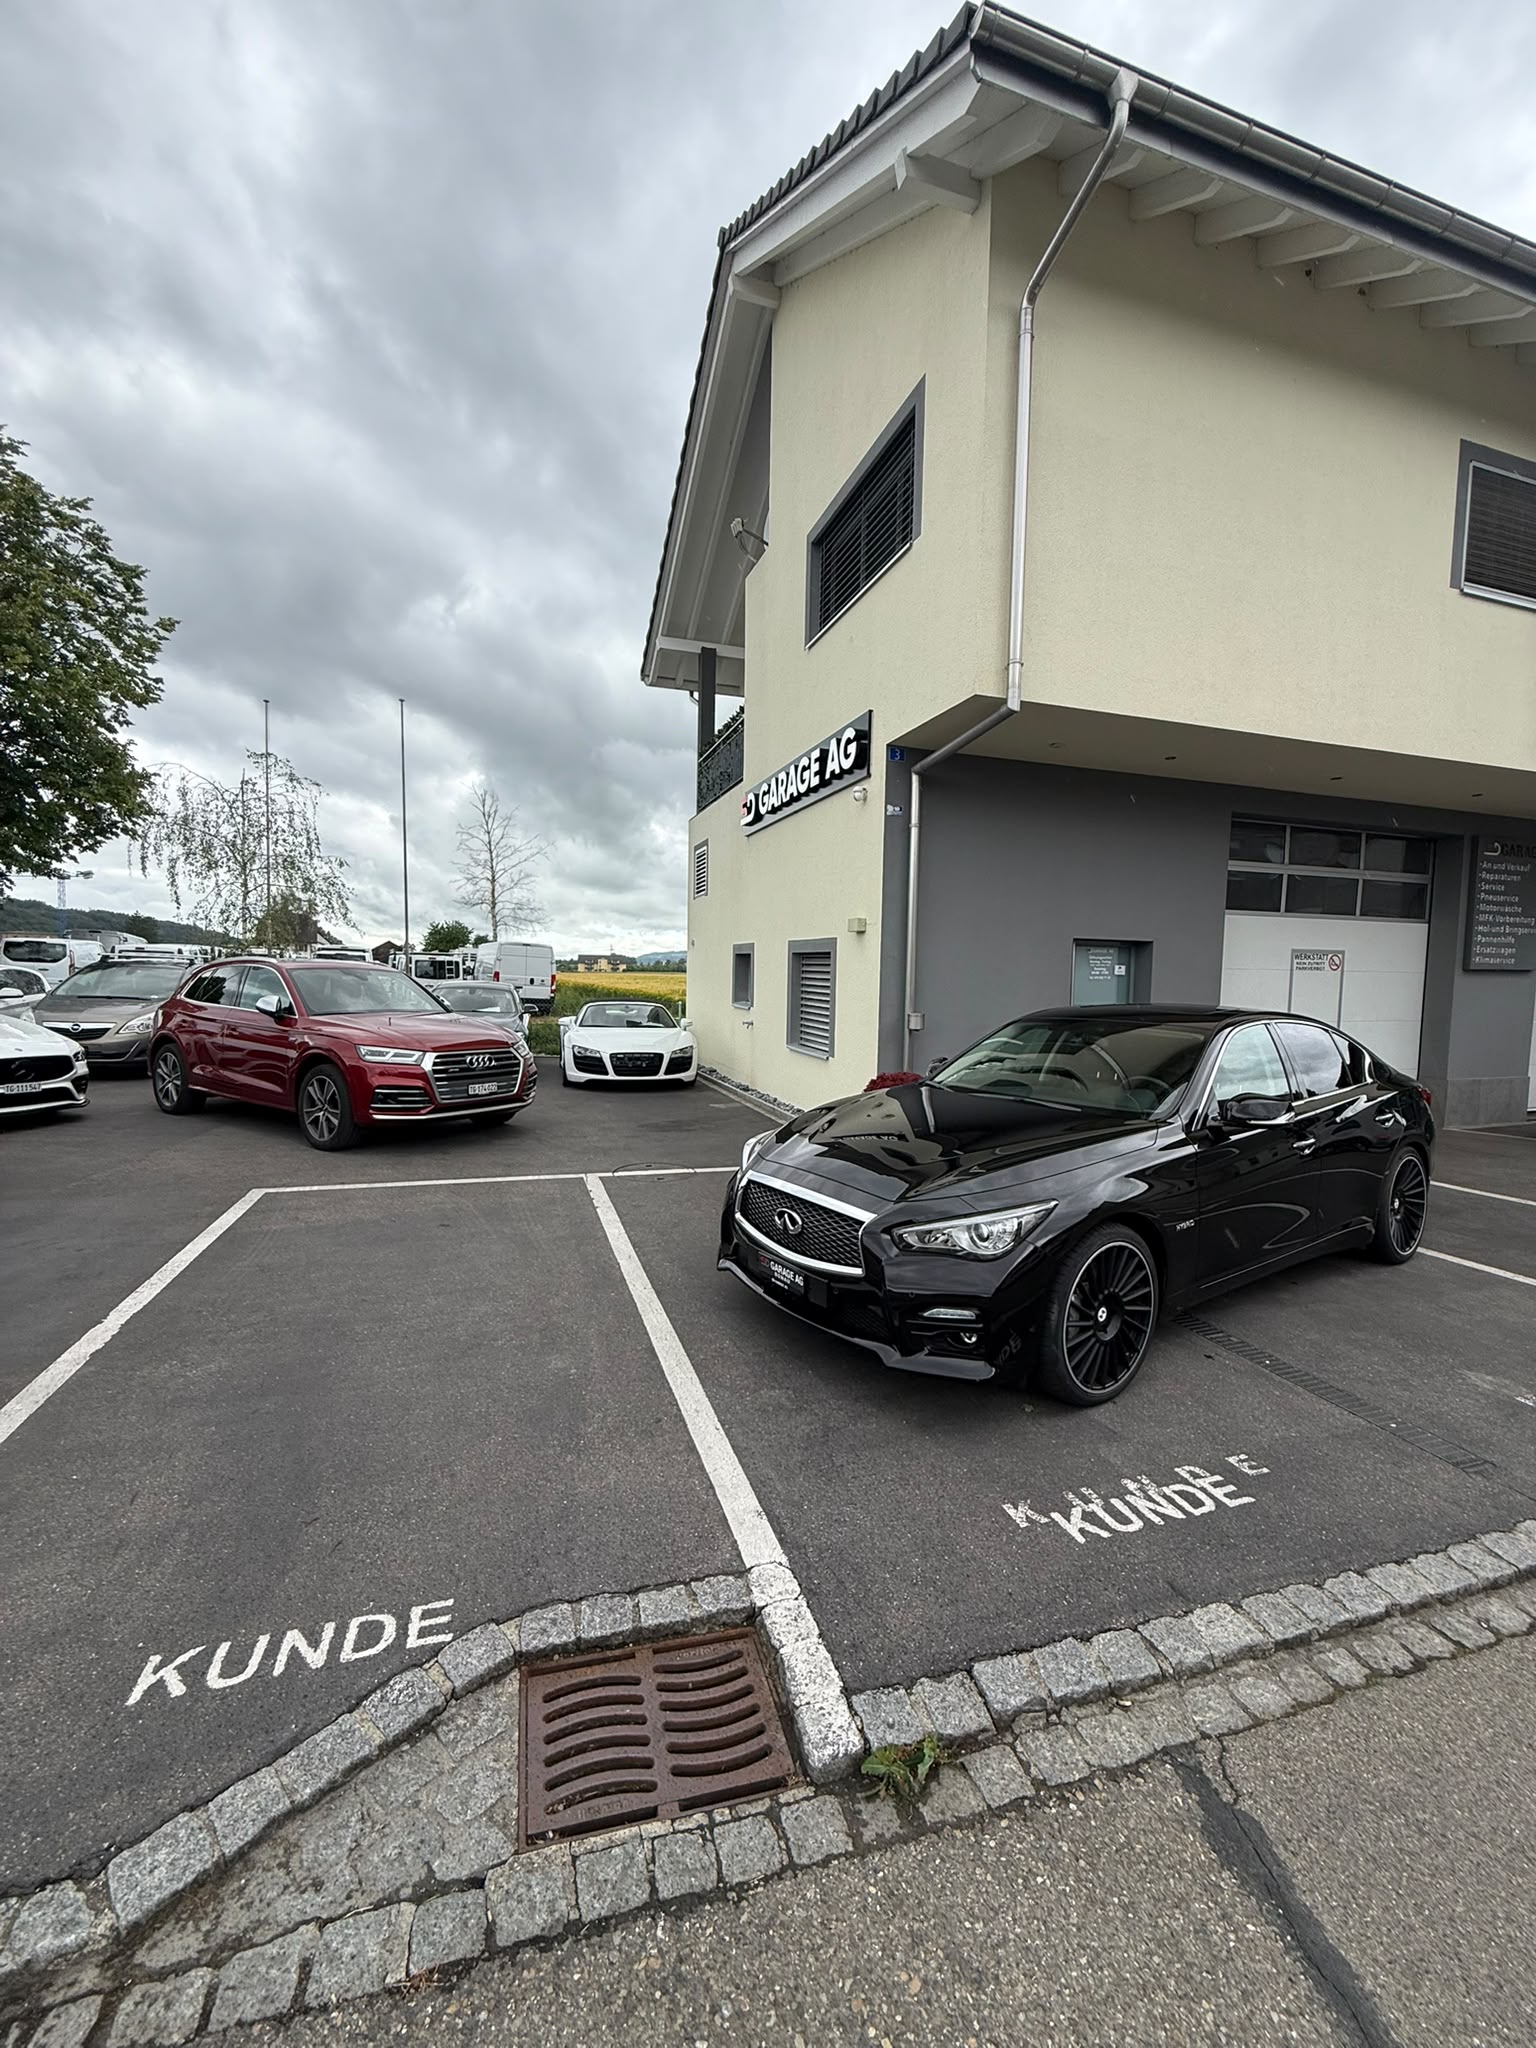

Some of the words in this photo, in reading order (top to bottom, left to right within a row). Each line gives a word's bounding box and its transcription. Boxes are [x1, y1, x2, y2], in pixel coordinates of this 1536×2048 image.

[894, 748, 901, 760] 3
[758, 747, 820, 815] GARAGE
[825, 726, 857, 780] AG
[1492, 862, 1505, 870] und
[1507, 863, 1531, 872] Verkauf
[1481, 871, 1521, 881] Reparaturen
[1481, 882, 1505, 891] Service
[1480, 893, 1519, 902] Pneuservice
[1477, 935, 1515, 944] Pannenhilfe
[1476, 946, 1516, 955] Ersatzwagen
[1294, 952, 1328, 960] WERKSTATT
[1475, 956, 1515, 965] Klimaservice
[770, 1261, 794, 1282] GARAGE
[795, 1274, 804, 1286] AG
[1050, 1475, 1256, 1544] KUNDE
[124, 1598, 455, 1705] KUNDE
